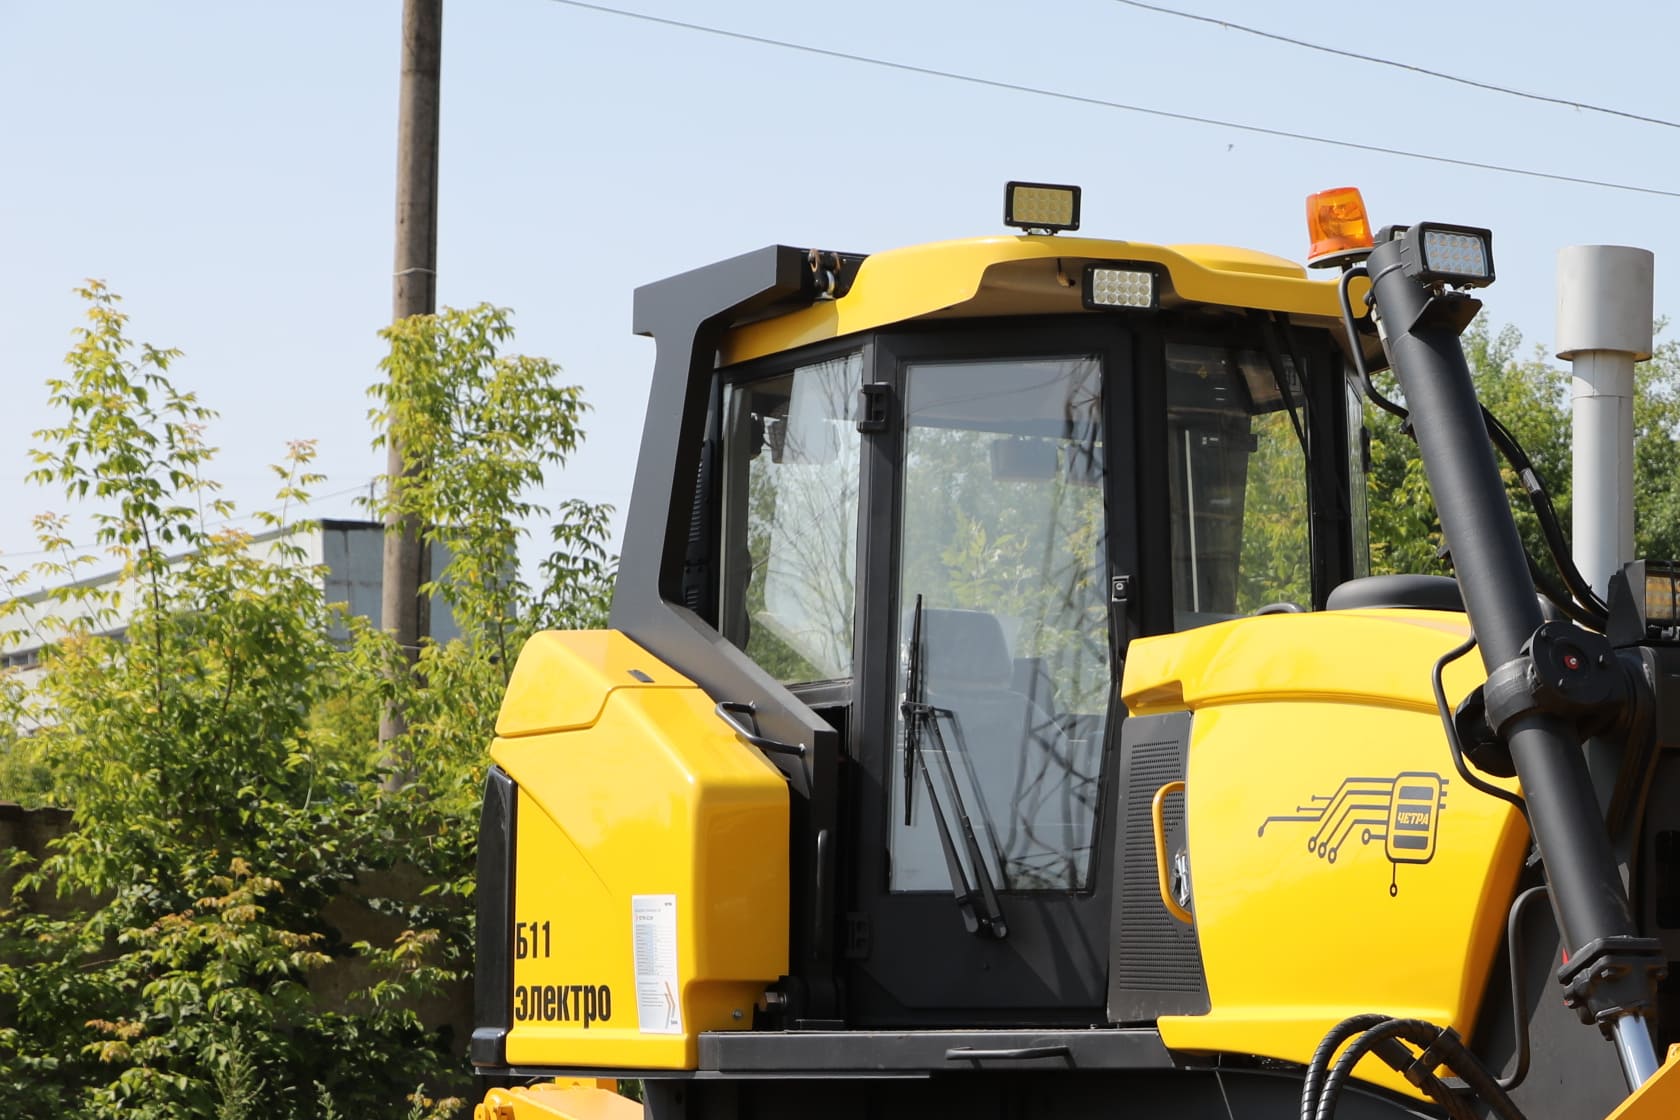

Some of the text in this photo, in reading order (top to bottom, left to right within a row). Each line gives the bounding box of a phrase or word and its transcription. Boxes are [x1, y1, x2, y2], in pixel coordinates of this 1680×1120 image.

[1397, 812, 1429, 825] ЧЕТРА
[516, 920, 551, 959] Б11
[515, 984, 612, 1029] электро
